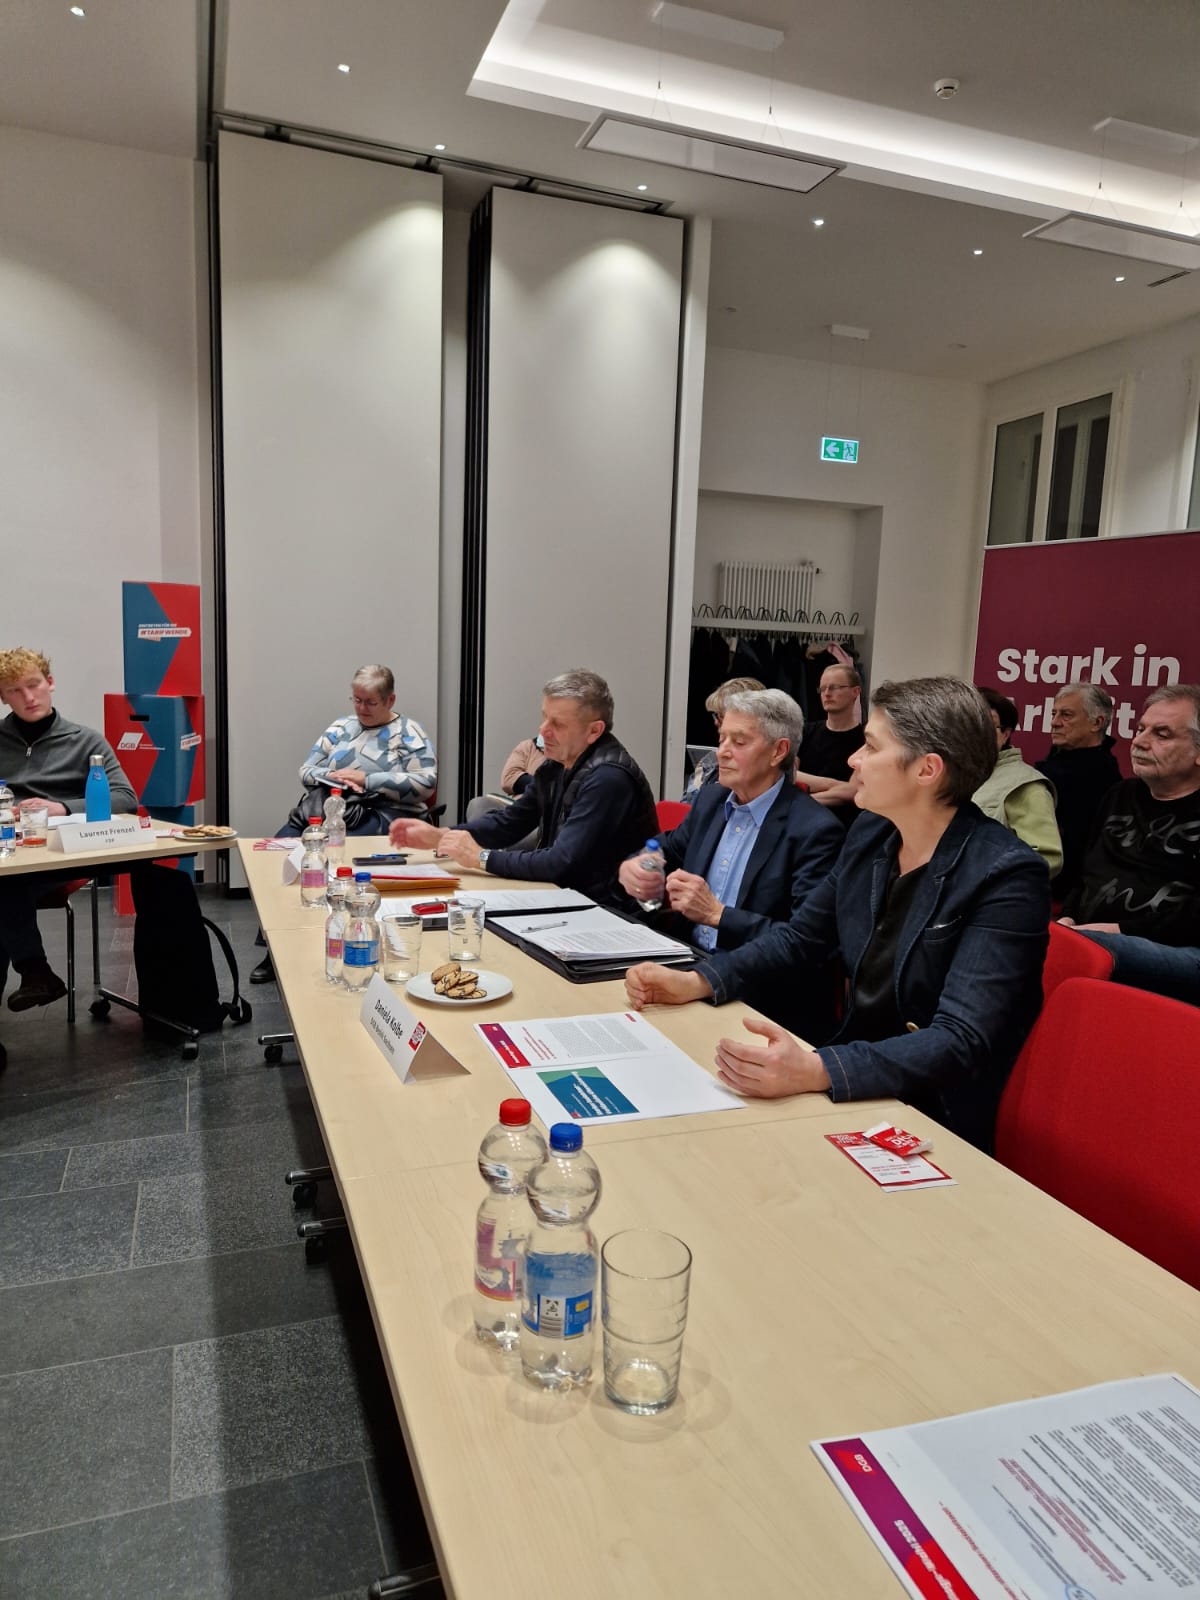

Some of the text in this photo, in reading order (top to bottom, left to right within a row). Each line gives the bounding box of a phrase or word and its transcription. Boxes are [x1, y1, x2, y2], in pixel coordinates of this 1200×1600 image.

[997, 643, 1181, 687] Stark in
[79, 826, 136, 839] Laurenz Frenzel
[374, 999, 403, 1039] Daniela Kolbe
[854, 1453, 873, 1472] DGB
